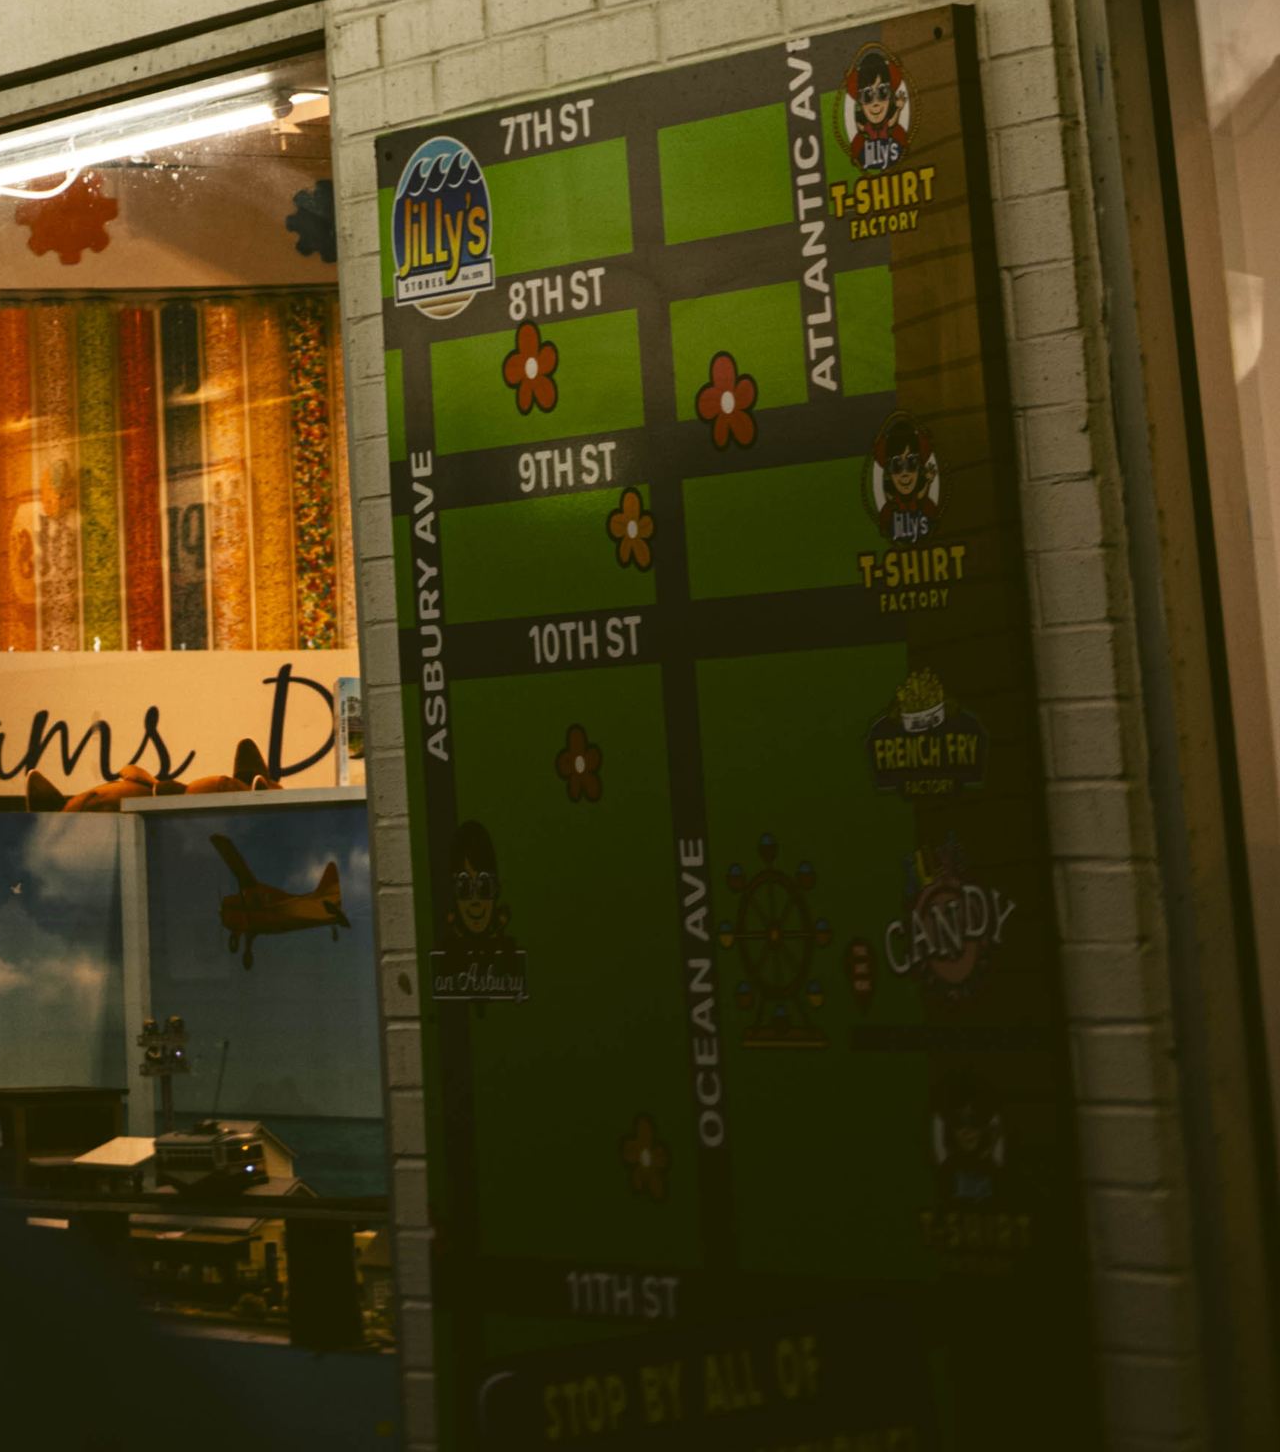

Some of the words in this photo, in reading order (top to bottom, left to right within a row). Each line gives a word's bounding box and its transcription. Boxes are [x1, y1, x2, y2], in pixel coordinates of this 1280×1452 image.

[499, 108, 553, 155] 7TH
[559, 98, 594, 142] ST
[830, 167, 936, 219] T-SHIRT
[849, 209, 920, 241] FACTORY
[793, 134, 837, 391] ATLANTIC
[507, 274, 564, 321] 8TH
[569, 267, 606, 310] ST
[518, 447, 574, 493] 9TH
[580, 441, 616, 485] ST
[410, 449, 437, 544] AVE
[859, 545, 966, 589] T-SHIRT
[880, 588, 950, 613] FACTORY
[416, 557, 449, 761] ASBURY
[528, 619, 599, 664] 10TH
[605, 615, 642, 659] ST
[874, 734, 941, 771] FRENCH
[945, 732, 979, 766] FRY
[678, 838, 710, 942] AVE
[884, 885, 1017, 976] CANDY
[687, 957, 725, 1148] OCEAN
[564, 1270, 635, 1318] 11TH
[640, 1274, 680, 1320] ST
[543, 1373, 628, 1441] STOP
[639, 1358, 686, 1424] BY
[703, 1347, 767, 1416] ALL
[771, 1333, 822, 1400] OF
